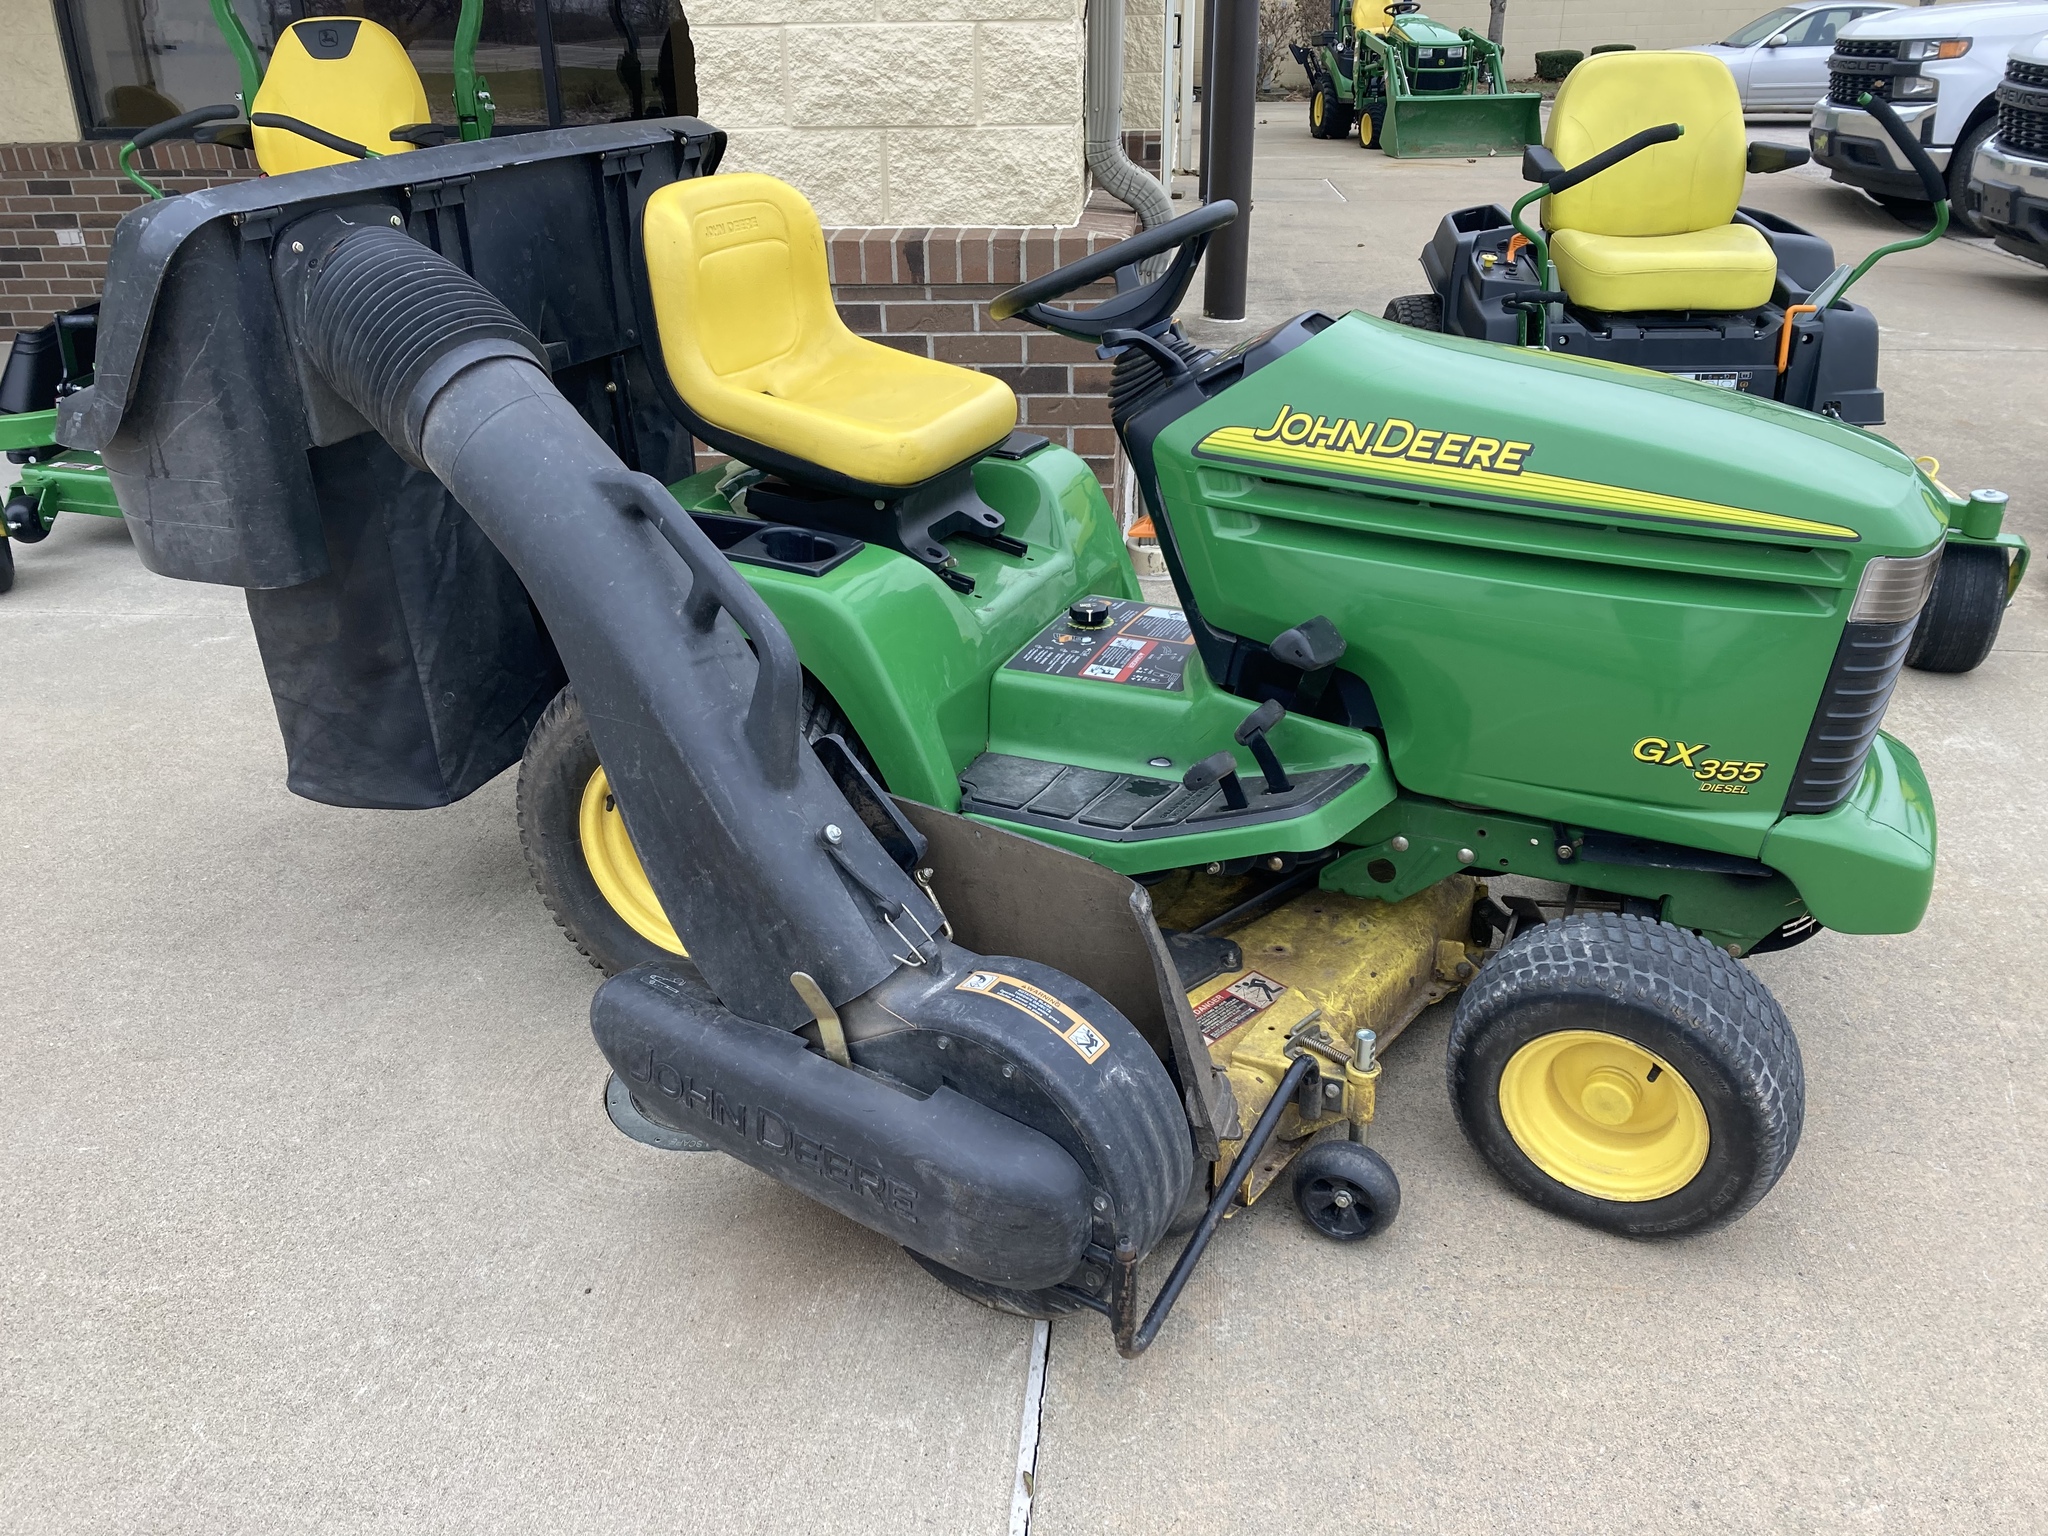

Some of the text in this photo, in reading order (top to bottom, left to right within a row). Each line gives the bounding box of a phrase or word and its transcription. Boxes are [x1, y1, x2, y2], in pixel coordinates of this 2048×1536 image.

[727, 216, 758, 232] DEERE
[1254, 404, 1536, 476] JOHN DEERE
[1700, 783, 1750, 796] DIESEL
[1027, 986, 1061, 1008] WARNING
[1193, 994, 1225, 1015] DANGER
[630, 1048, 920, 1224] JOHN DEERE
[669, 1137, 704, 1149] SCAPE
